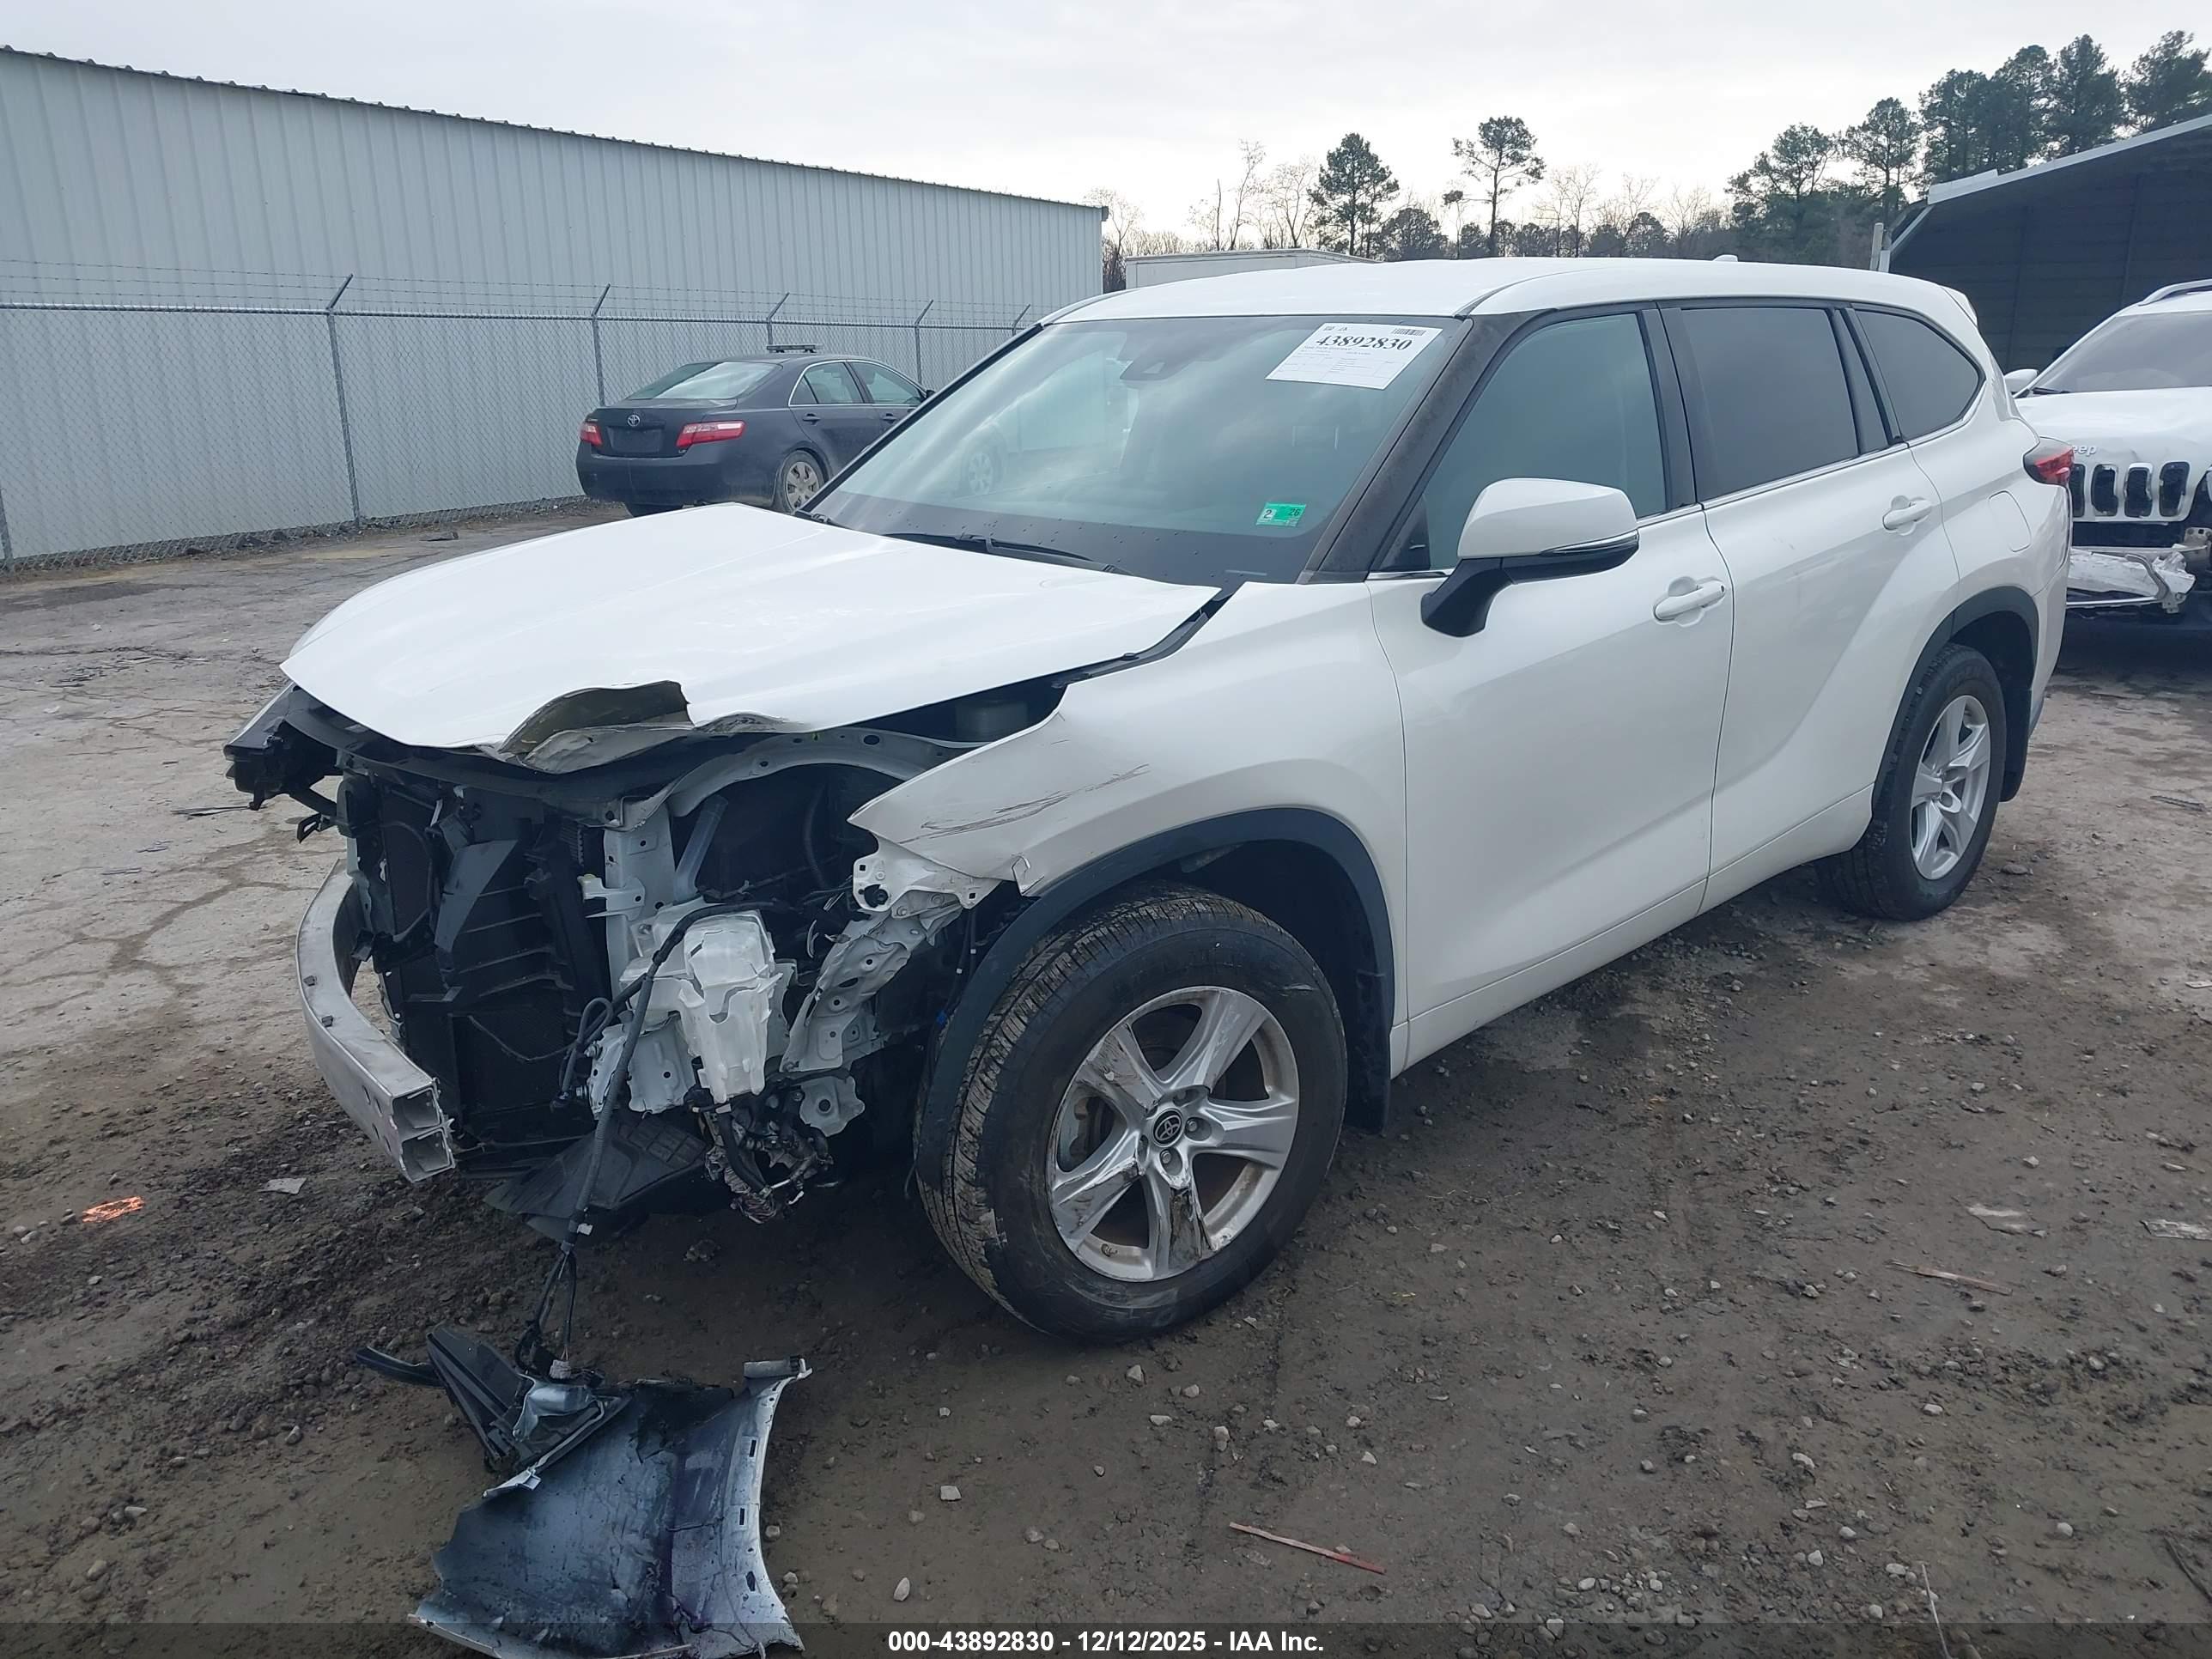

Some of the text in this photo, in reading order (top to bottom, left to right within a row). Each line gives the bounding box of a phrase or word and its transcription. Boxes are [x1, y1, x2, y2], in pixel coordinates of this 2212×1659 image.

[1316, 335, 1413, 350] 43892830
[2072, 444, 2097, 456] eep
[1262, 508, 1273, 520] 2
